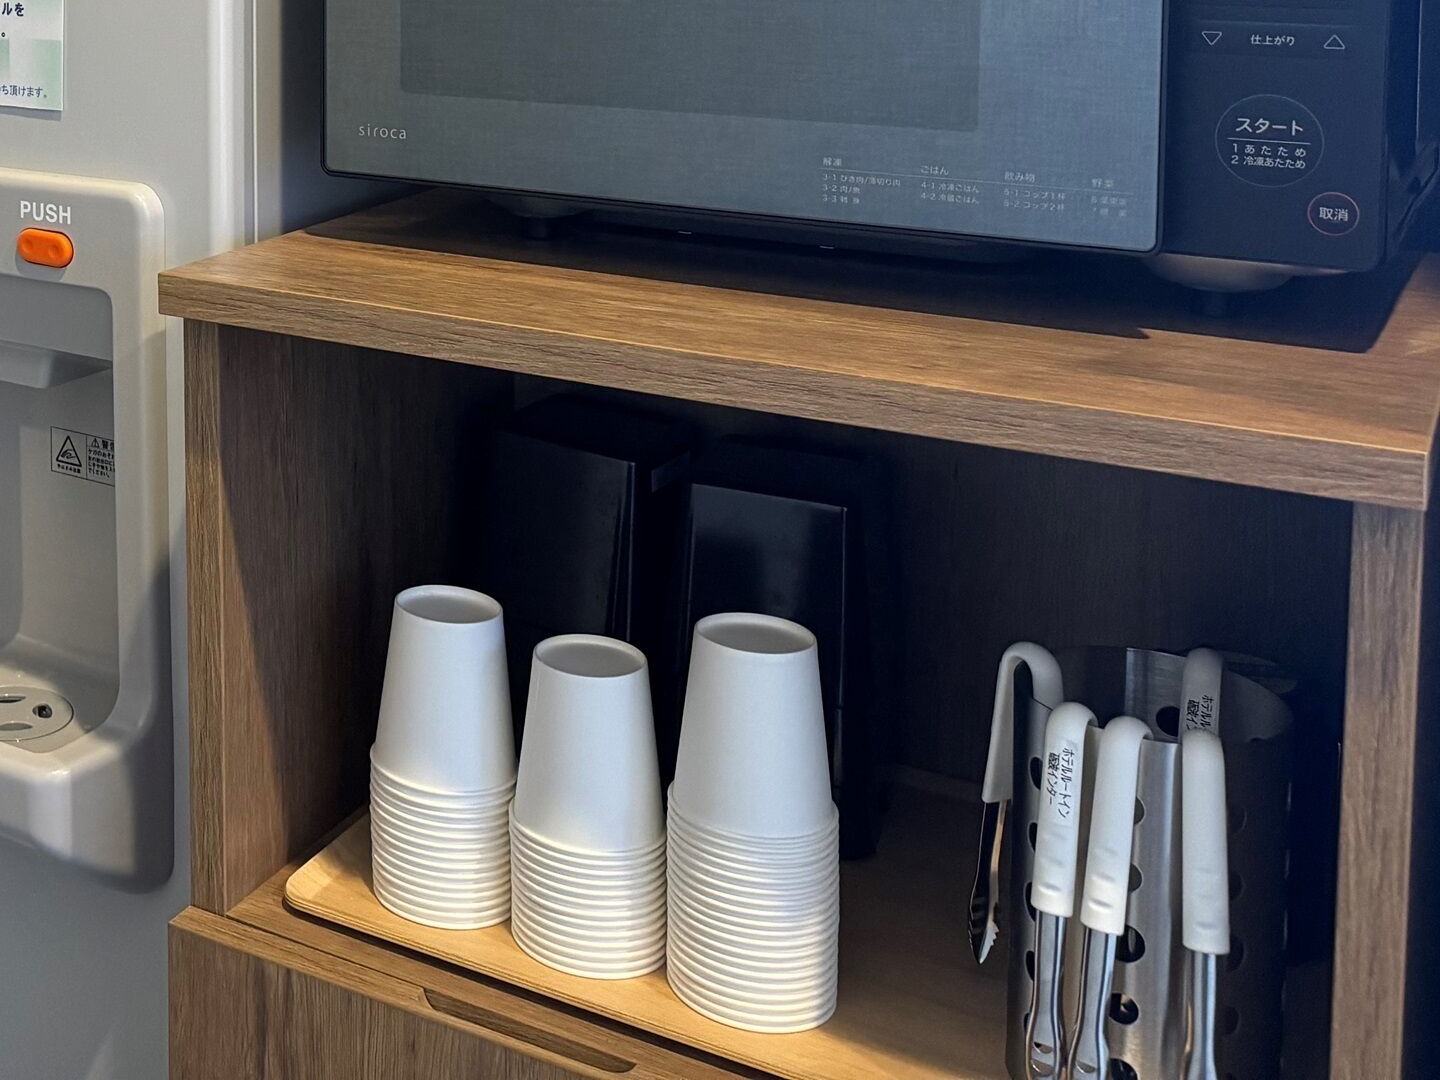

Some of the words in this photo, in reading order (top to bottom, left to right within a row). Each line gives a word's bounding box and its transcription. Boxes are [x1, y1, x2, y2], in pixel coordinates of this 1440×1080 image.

[1251, 34, 1295, 46] 仕上がり
[359, 123, 407, 139] siroca
[1235, 118, 1303, 136] スタート
[1231, 155, 1239, 165] 2
[1243, 156, 1306, 169] 冷凍あたため
[920, 165, 949, 176] ごはん
[20, 200, 72, 224] PUSH
[1319, 207, 1348, 222] 取消
[1058, 748, 1075, 818] ホテルルートイン
